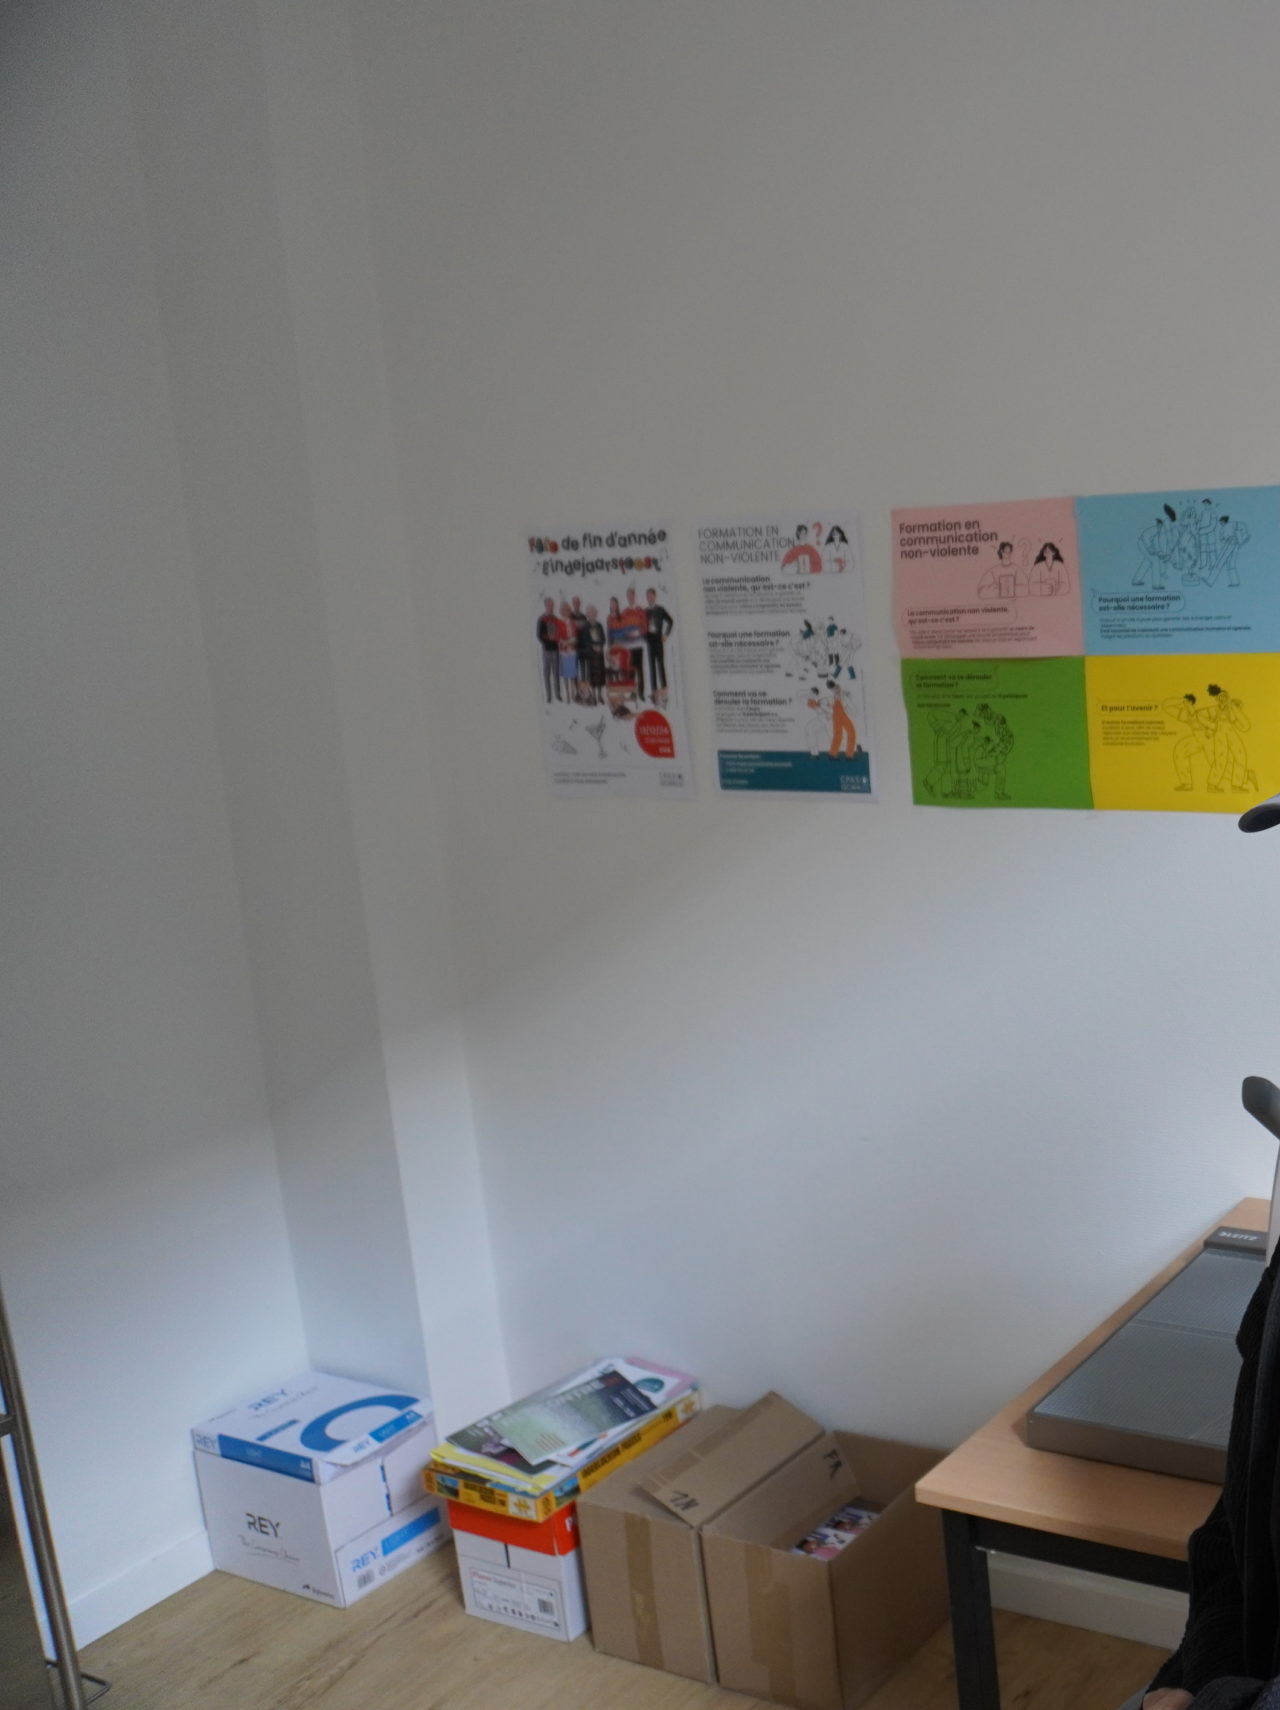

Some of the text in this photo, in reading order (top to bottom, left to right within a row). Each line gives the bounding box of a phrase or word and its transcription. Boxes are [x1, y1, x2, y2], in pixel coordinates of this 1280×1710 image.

[698, 525, 779, 539] FORMATION EN
[899, 520, 980, 534] Formation en
[561, 536, 579, 551] de
[582, 533, 602, 549] fin
[699, 538, 795, 552] COMMUNICATION
[900, 530, 998, 547] communication
[700, 551, 780, 565] NON-VIOLENTE
[901, 545, 979, 559] non-violente
[245, 1512, 280, 1538] REY
[351, 1546, 378, 1573] REY
